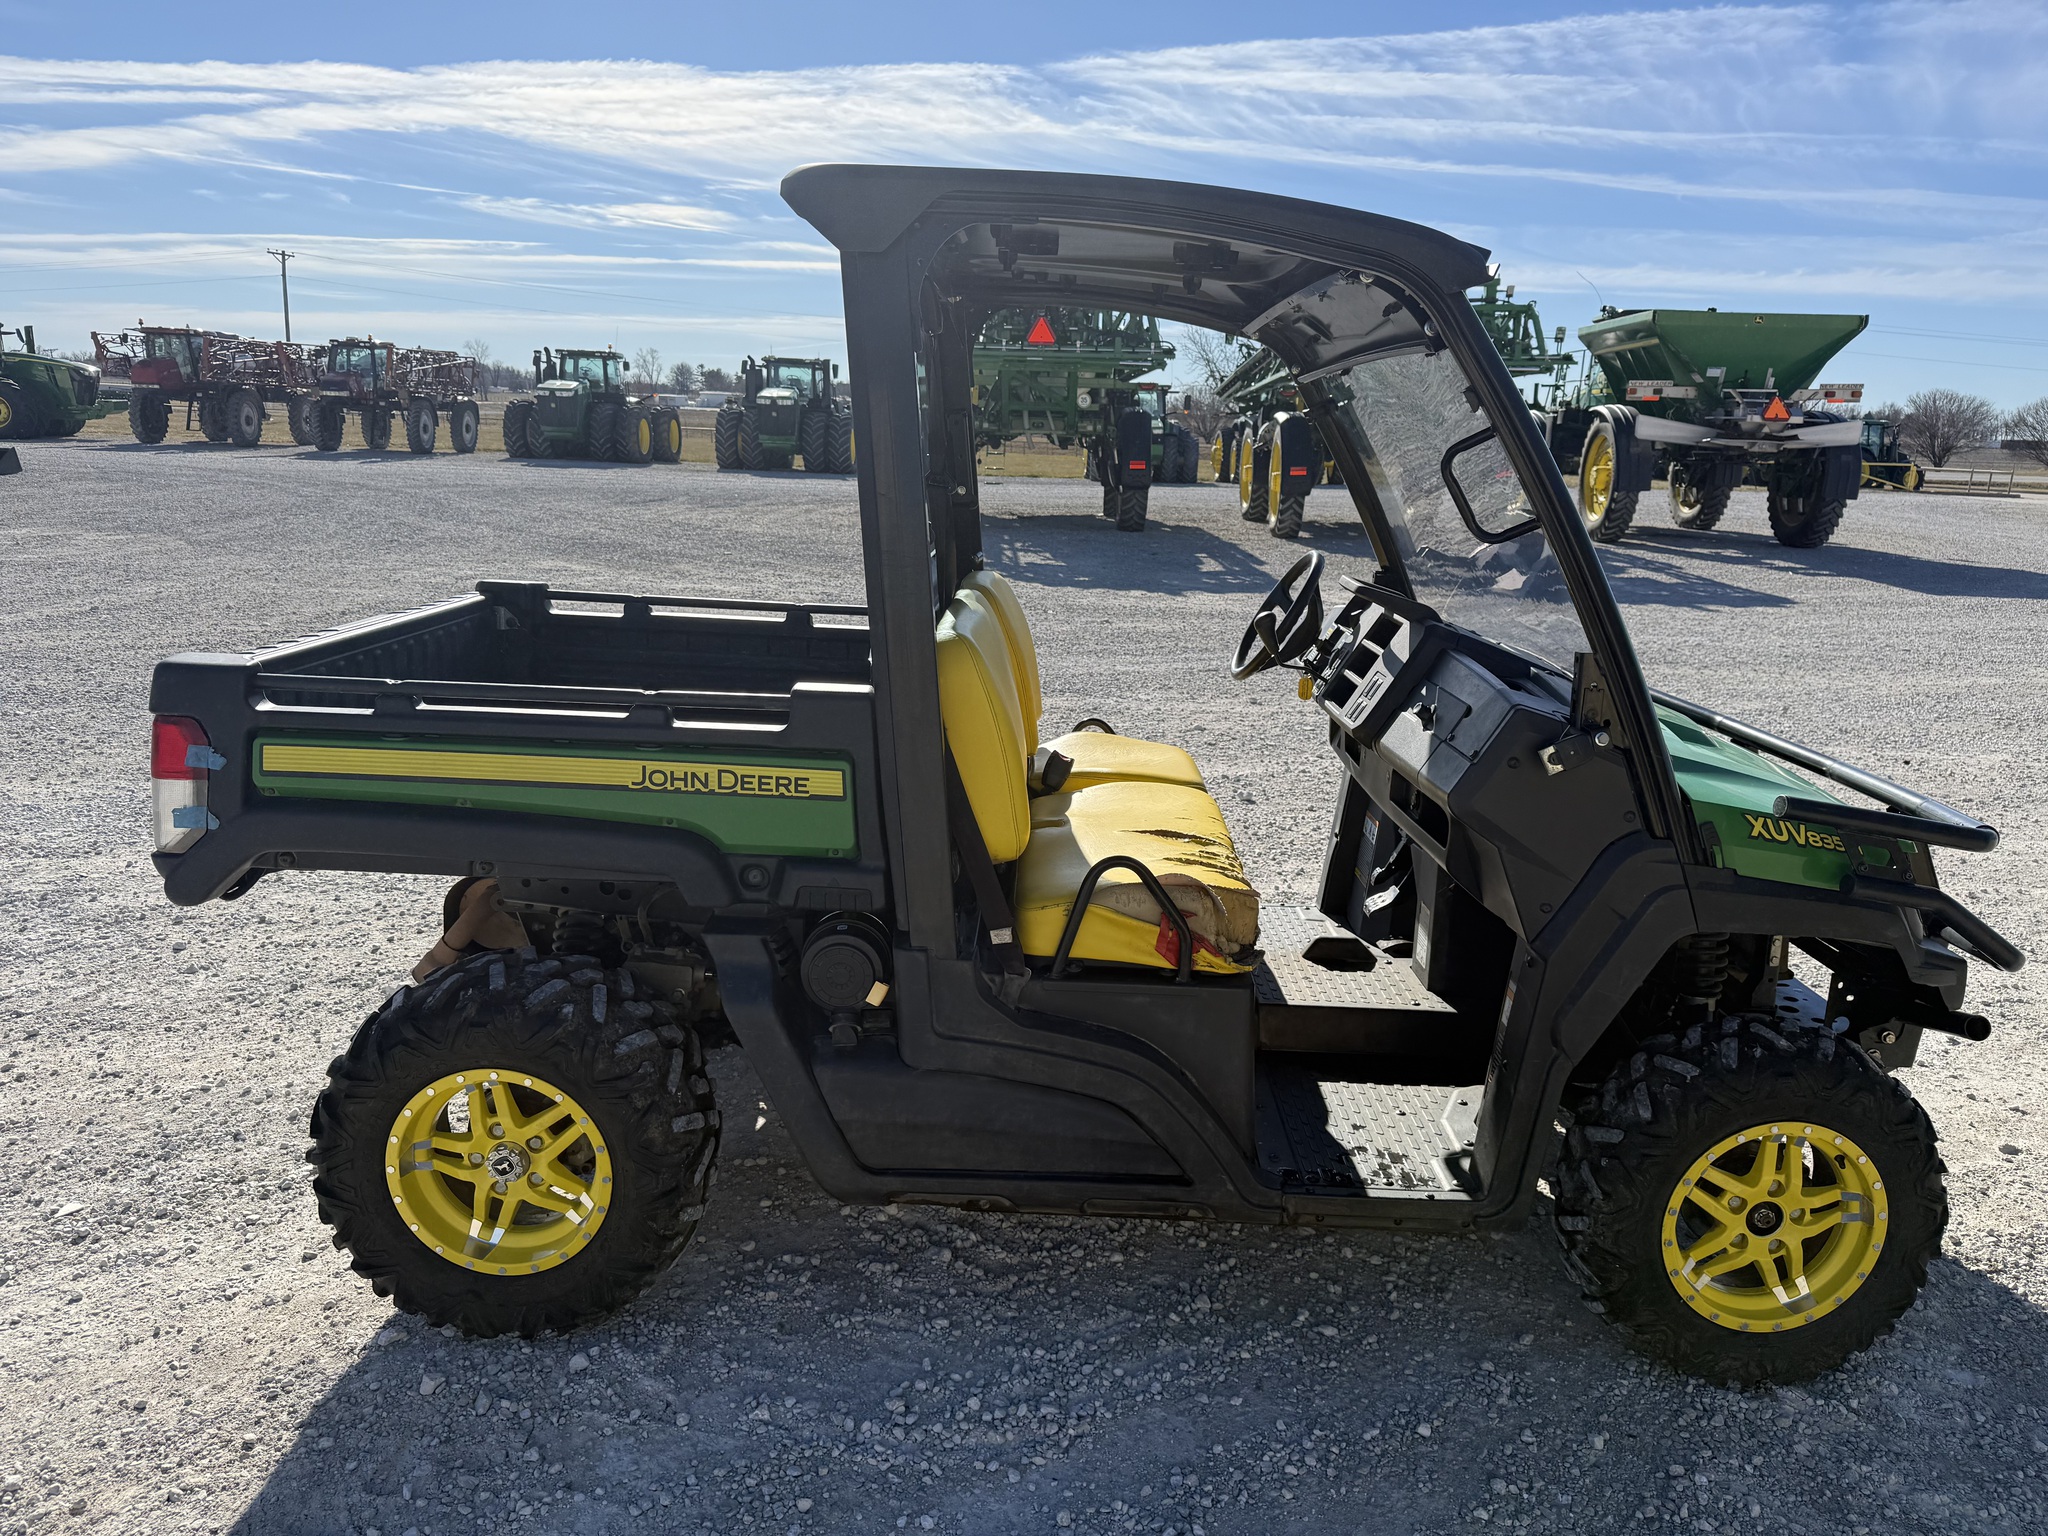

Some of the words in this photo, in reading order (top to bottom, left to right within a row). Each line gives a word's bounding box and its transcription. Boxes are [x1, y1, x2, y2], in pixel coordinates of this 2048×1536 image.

[631, 765, 709, 790] JOHN
[717, 769, 810, 795] DEERE
[1744, 813, 1863, 856] XUV835
